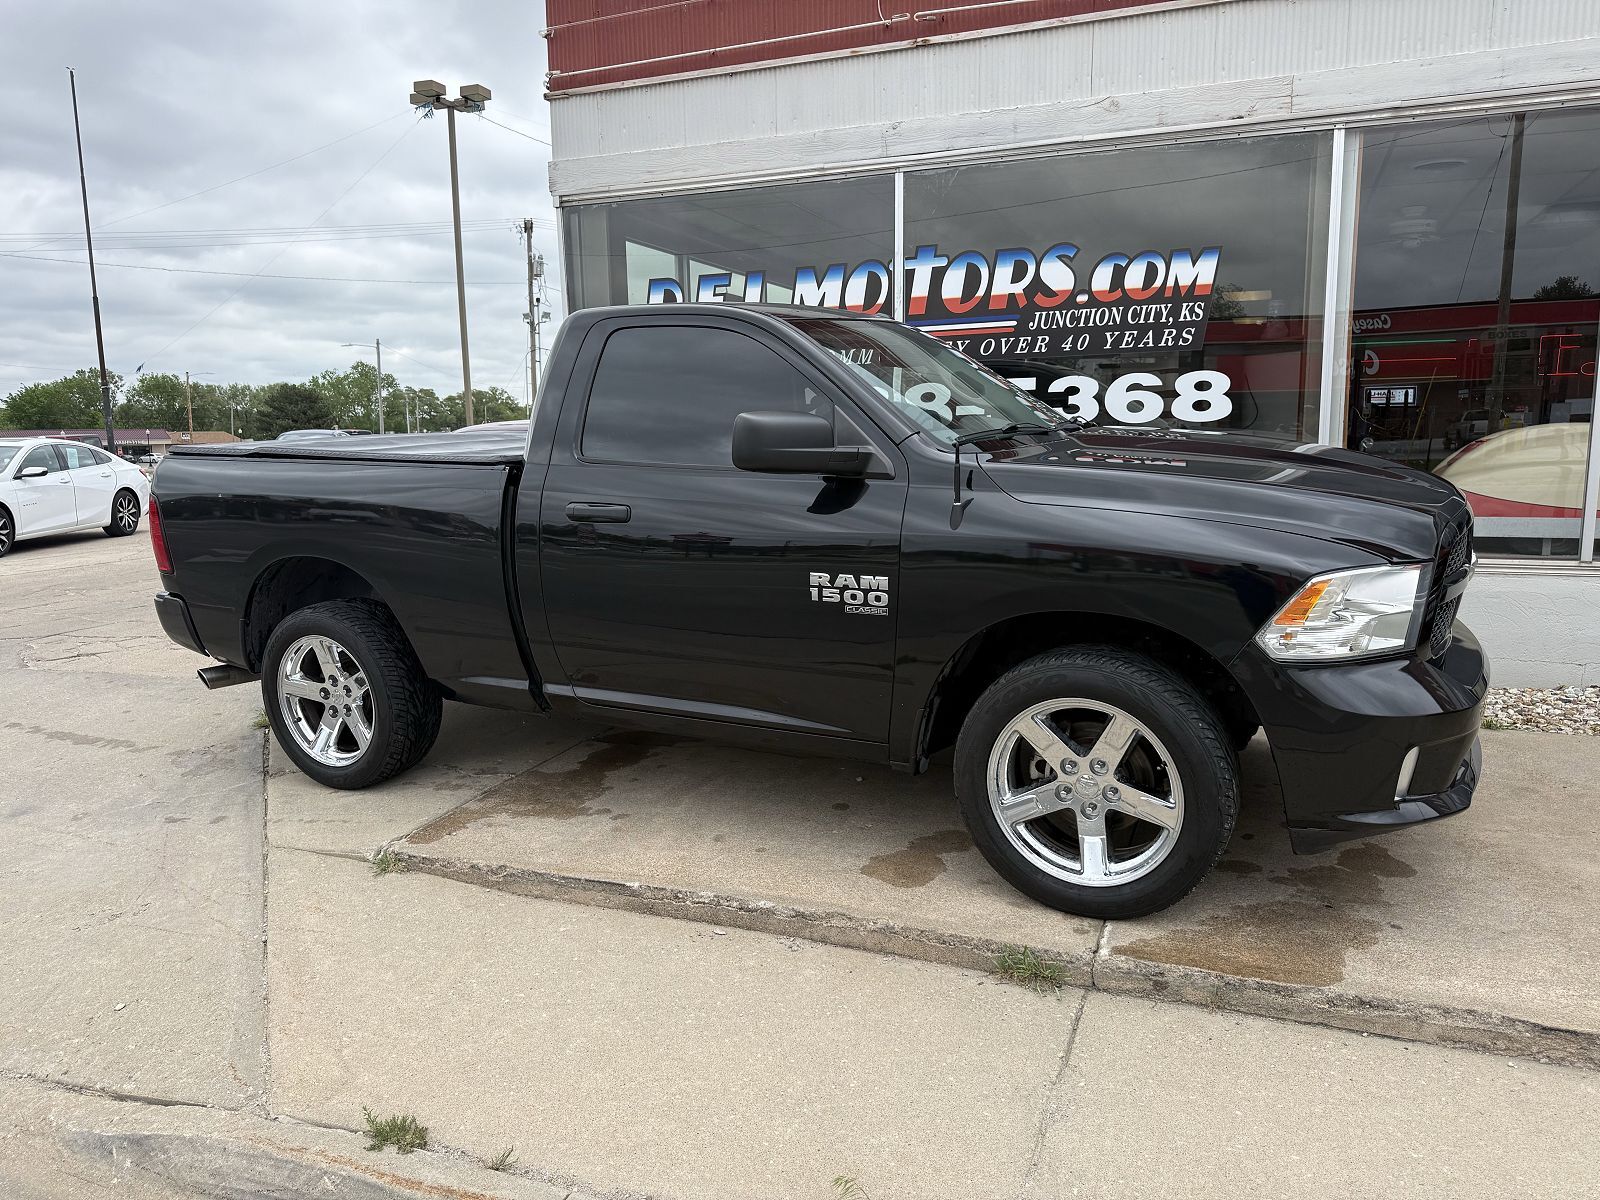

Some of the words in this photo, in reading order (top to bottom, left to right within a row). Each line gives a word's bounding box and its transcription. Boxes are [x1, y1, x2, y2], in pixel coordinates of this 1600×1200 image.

[1029, 305, 1124, 330] JUNCTION
[1127, 303, 1173, 326] CITY,
[1178, 302, 1205, 322] KS
[980, 336, 1050, 356] OVER
[1061, 333, 1091, 351] 40
[1103, 327, 1196, 349] YEARS
[810, 572, 888, 590] RAM
[810, 588, 888, 606] 1500
[846, 606, 888, 615] CLASSIC
